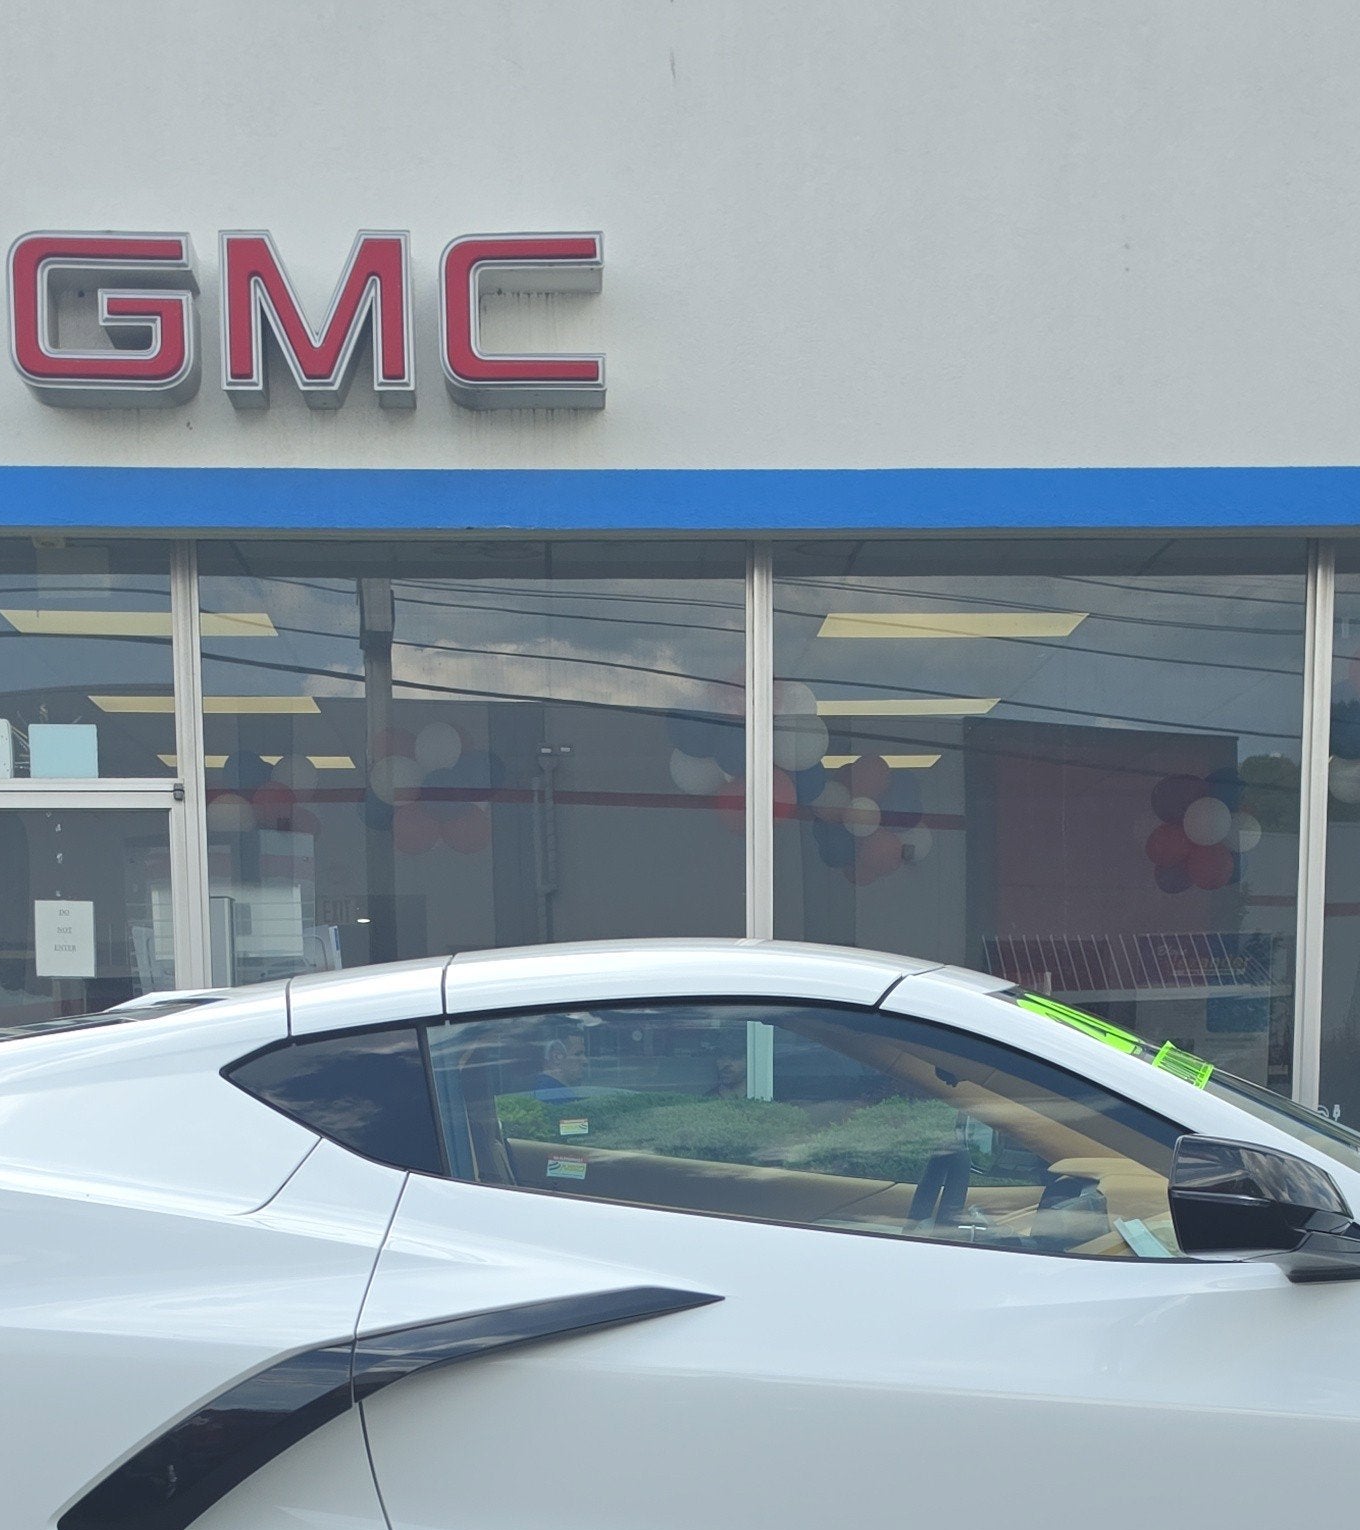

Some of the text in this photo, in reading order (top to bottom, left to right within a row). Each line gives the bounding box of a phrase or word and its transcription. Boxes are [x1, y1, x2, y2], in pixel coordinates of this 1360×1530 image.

[7, 229, 606, 404] GMC
[57, 926, 72, 934] NOT
[54, 944, 77, 953] ENTER
